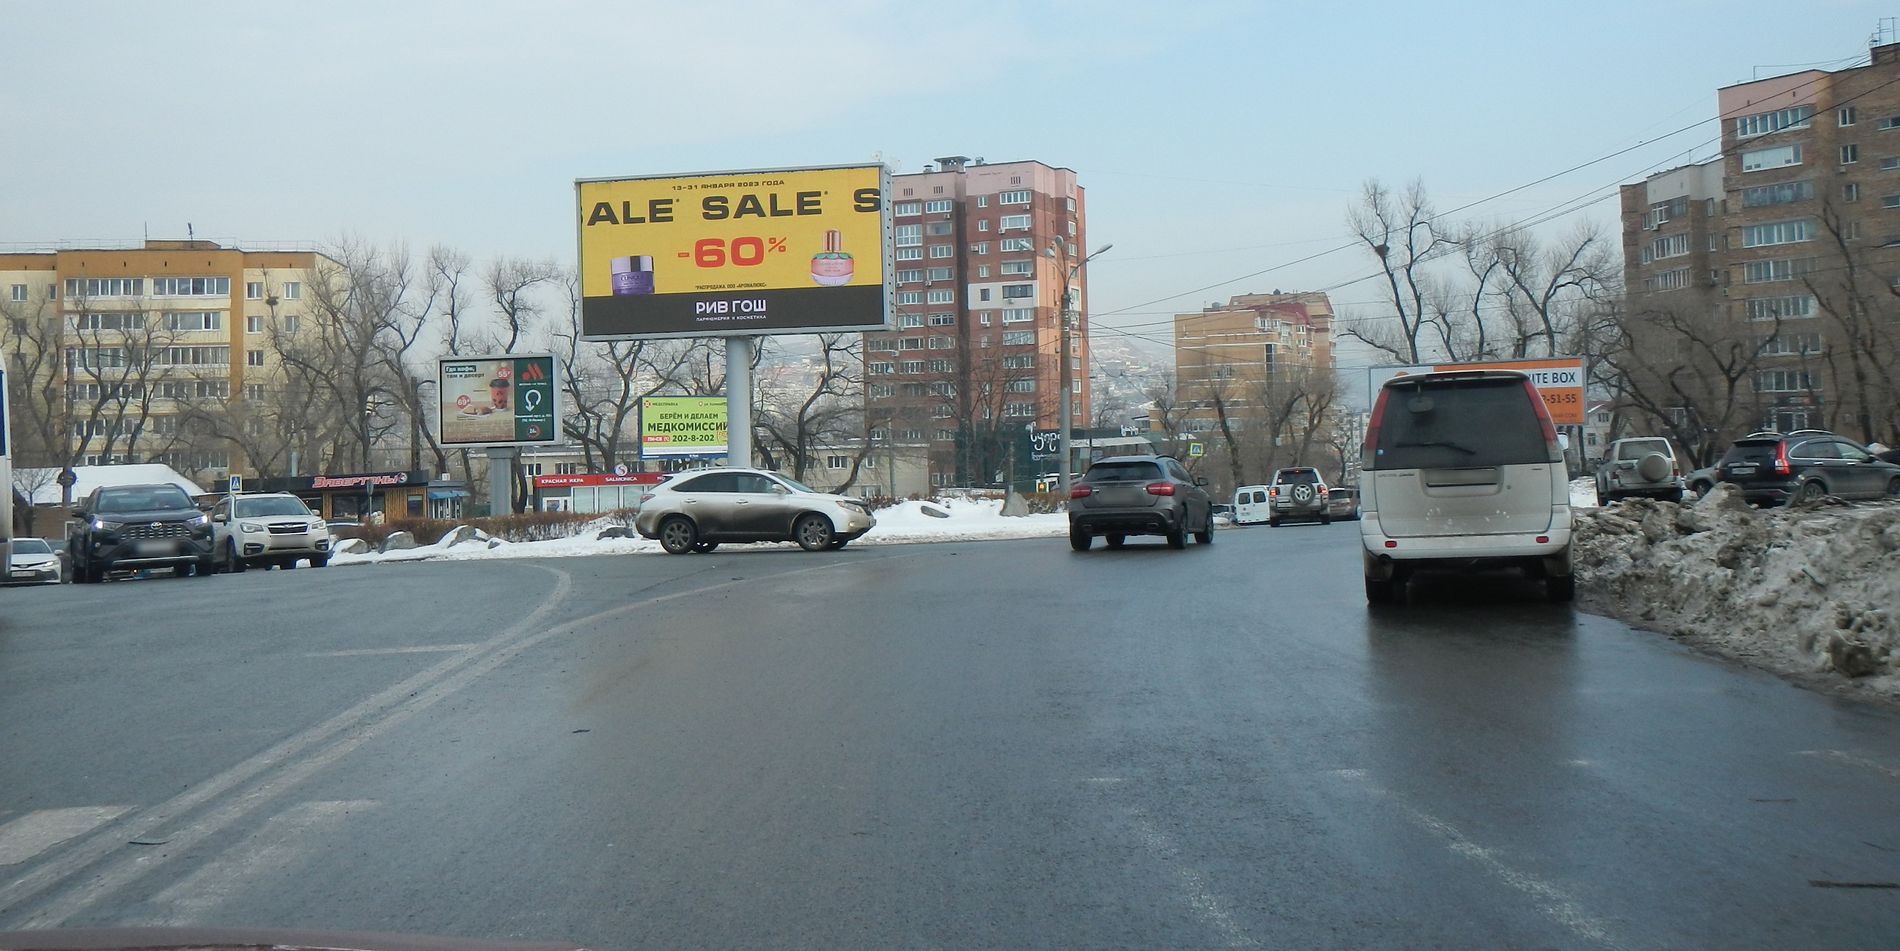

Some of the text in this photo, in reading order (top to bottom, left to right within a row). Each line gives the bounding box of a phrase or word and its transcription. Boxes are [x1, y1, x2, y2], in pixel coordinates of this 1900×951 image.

[678, 236, 787, 268] -60%
[696, 300, 767, 314] РИВ ГОШ
[1552, 372, 1575, 383] BOX
